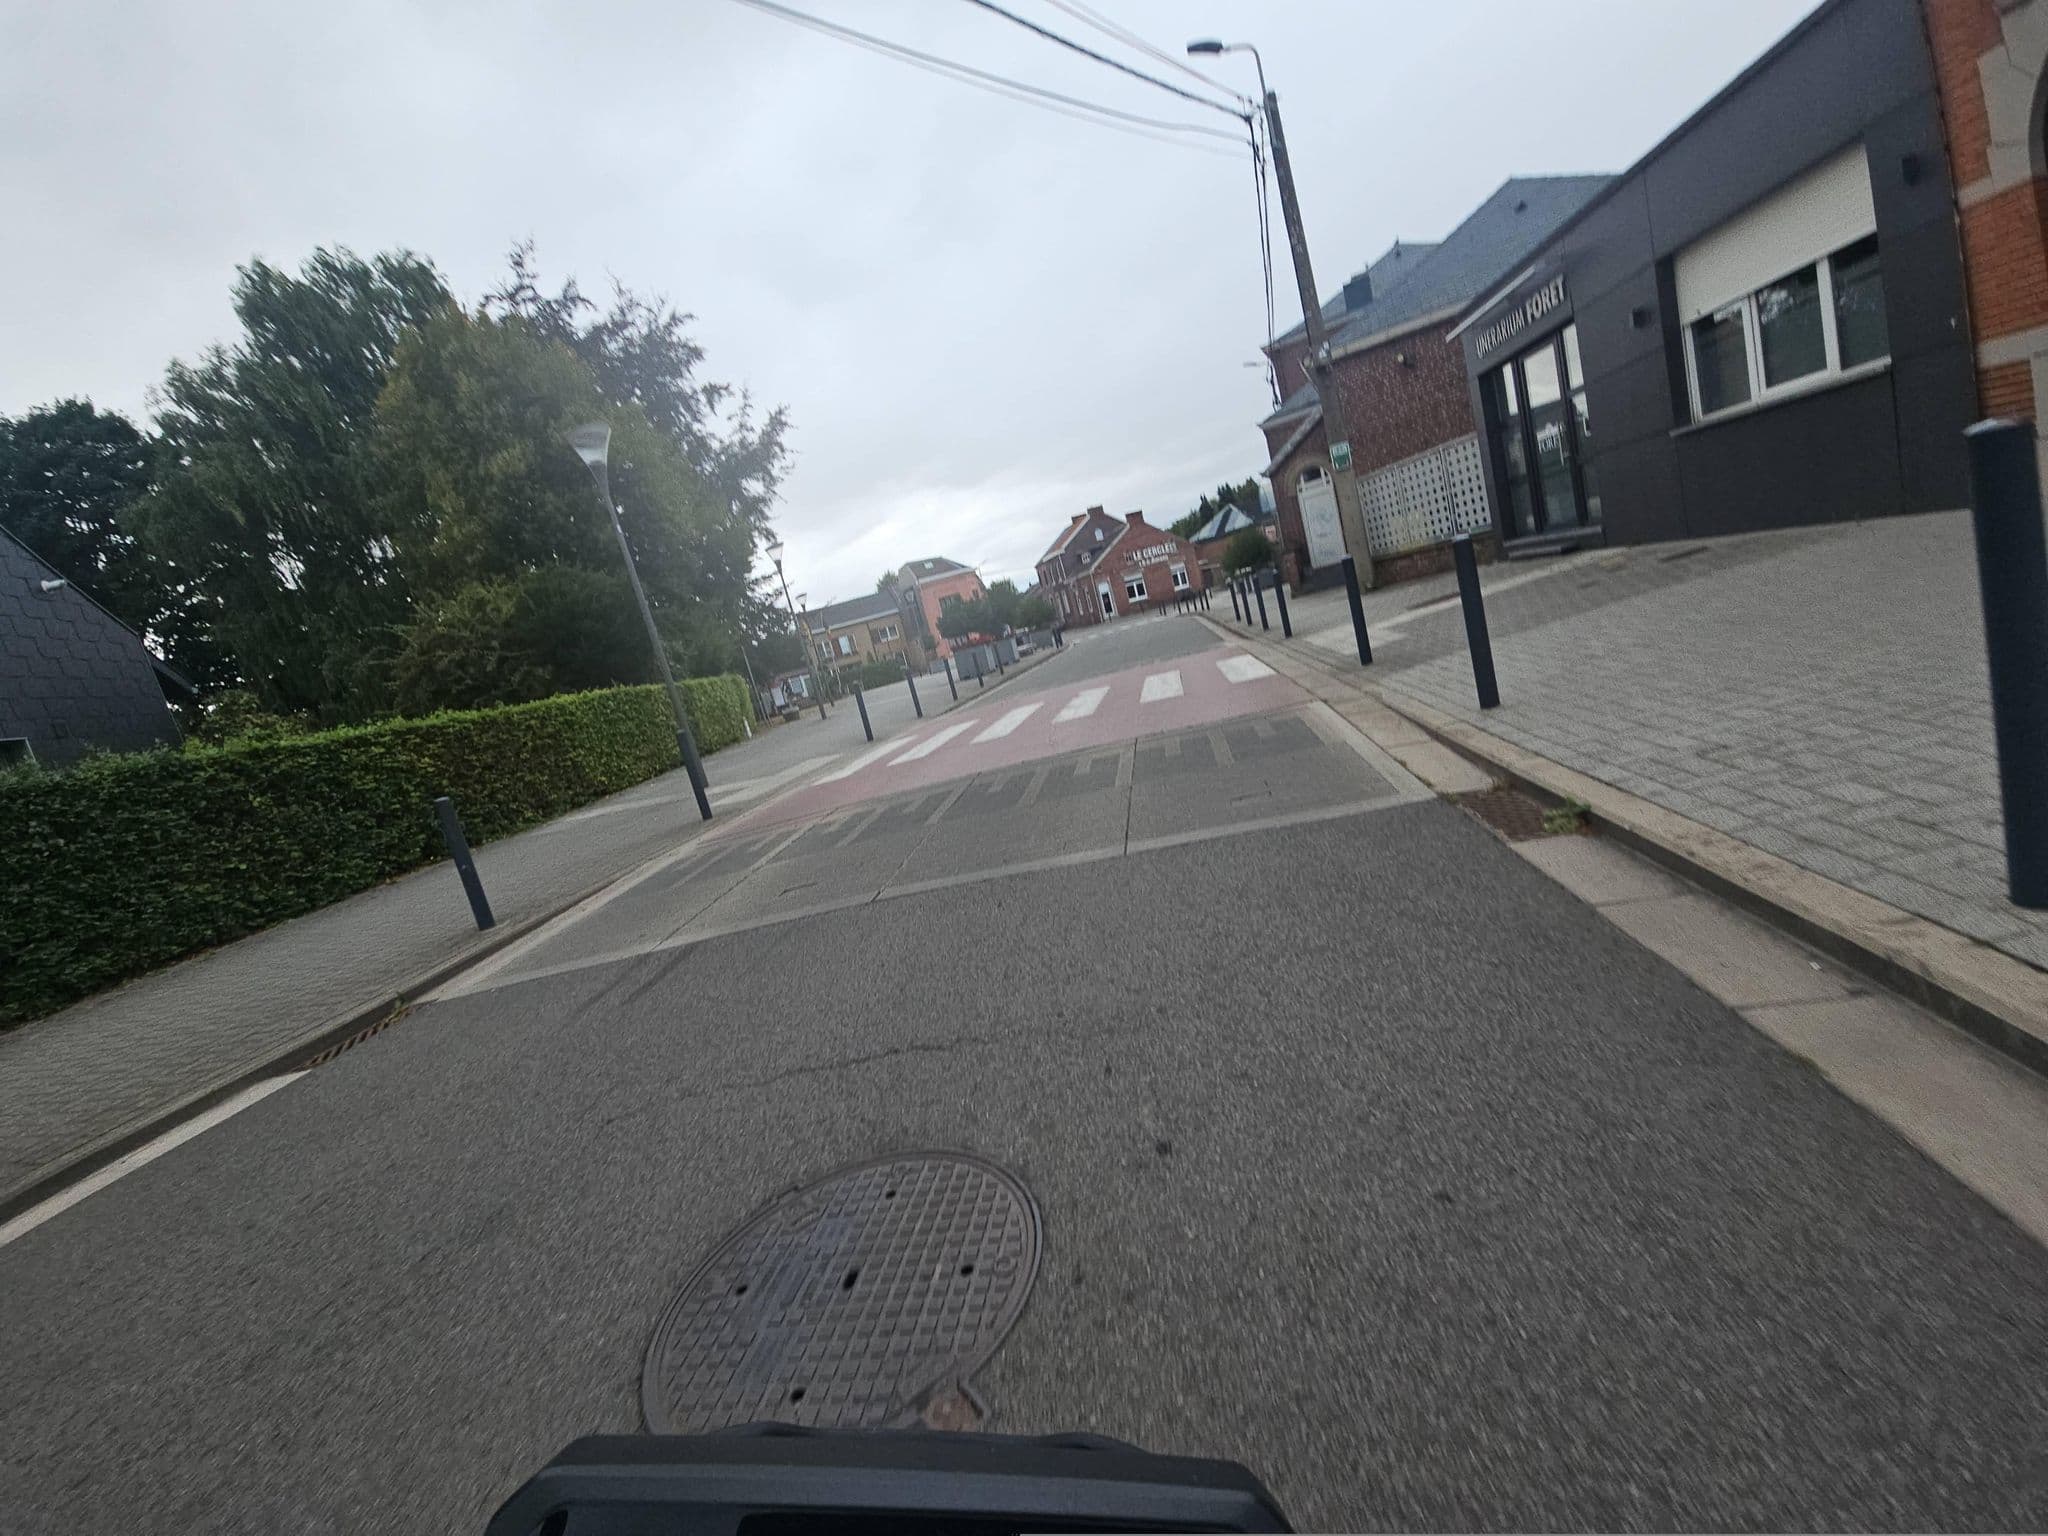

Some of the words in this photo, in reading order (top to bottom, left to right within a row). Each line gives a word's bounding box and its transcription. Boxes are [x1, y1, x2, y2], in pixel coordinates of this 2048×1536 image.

[1526, 273, 1565, 324] FORET
[1132, 549, 1141, 561] LE
[1143, 543, 1170, 558] CERCLE
